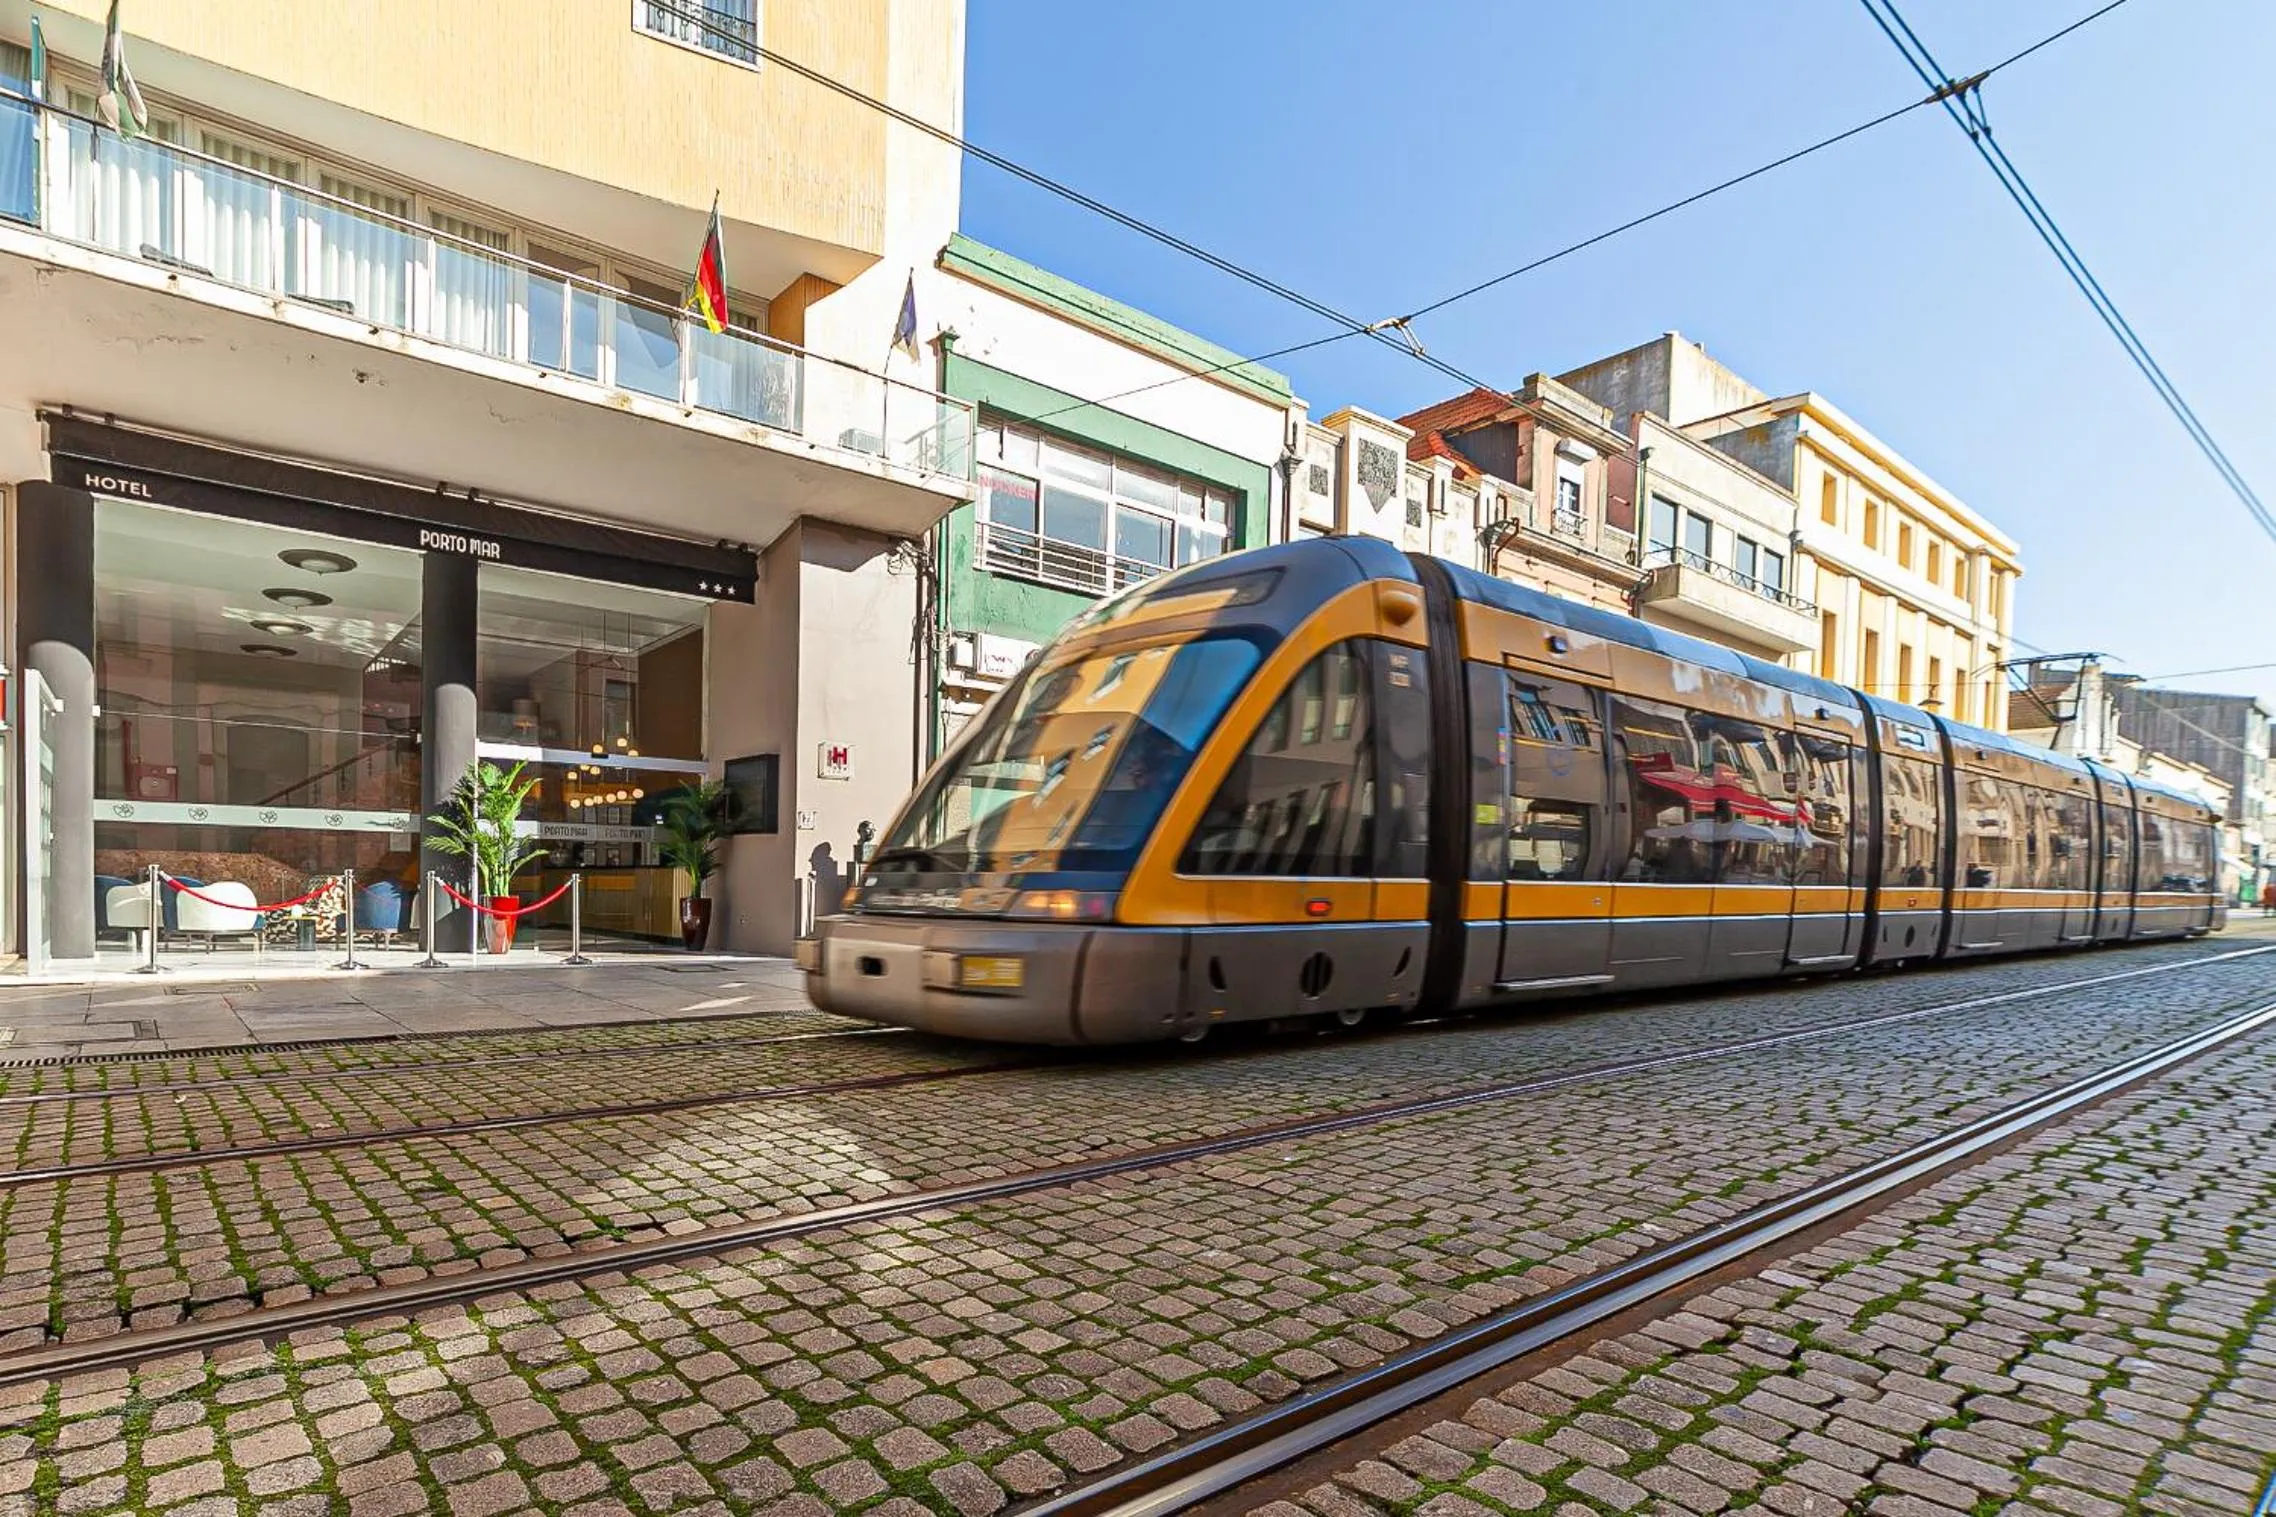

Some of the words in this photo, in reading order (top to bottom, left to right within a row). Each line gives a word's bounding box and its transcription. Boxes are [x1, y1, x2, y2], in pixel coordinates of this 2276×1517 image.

[85, 473, 152, 498] HOTEL
[420, 529, 467, 553] PORTO
[469, 538, 500, 559] MAR
